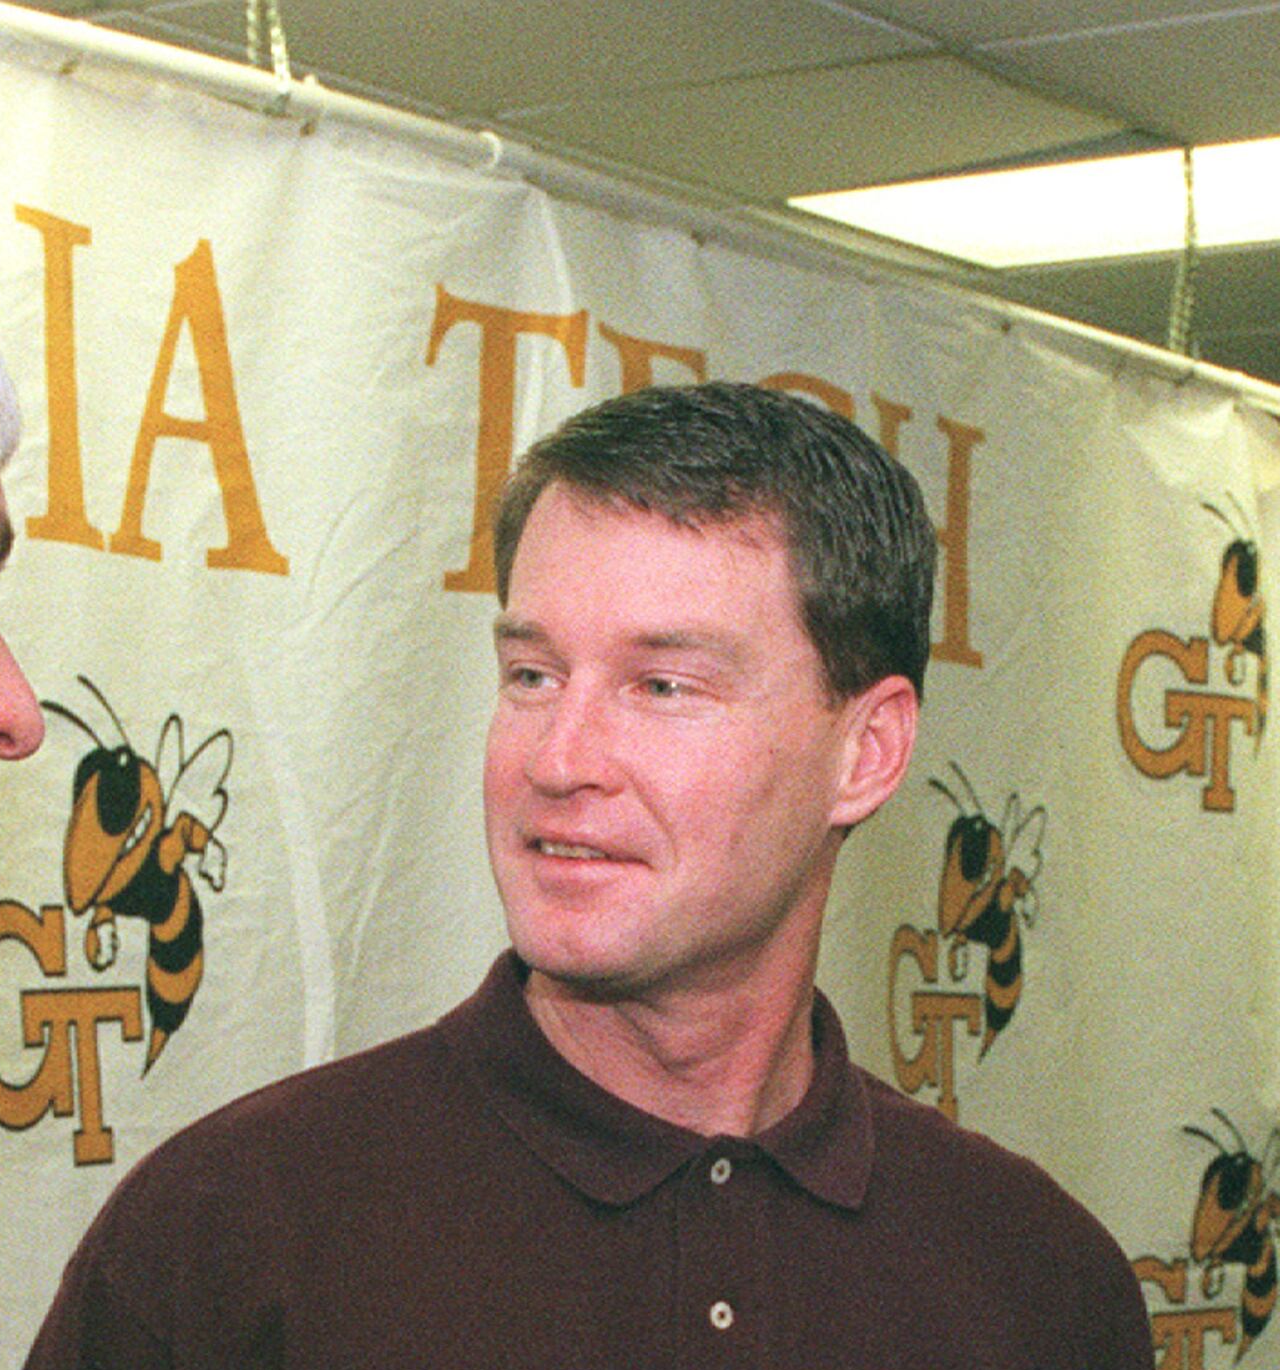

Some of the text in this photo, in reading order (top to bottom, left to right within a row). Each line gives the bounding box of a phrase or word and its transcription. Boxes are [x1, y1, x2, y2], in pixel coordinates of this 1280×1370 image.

[425, 284, 984, 668] TH
[1116, 628, 1258, 812] GT
[887, 923, 981, 1124] GT
